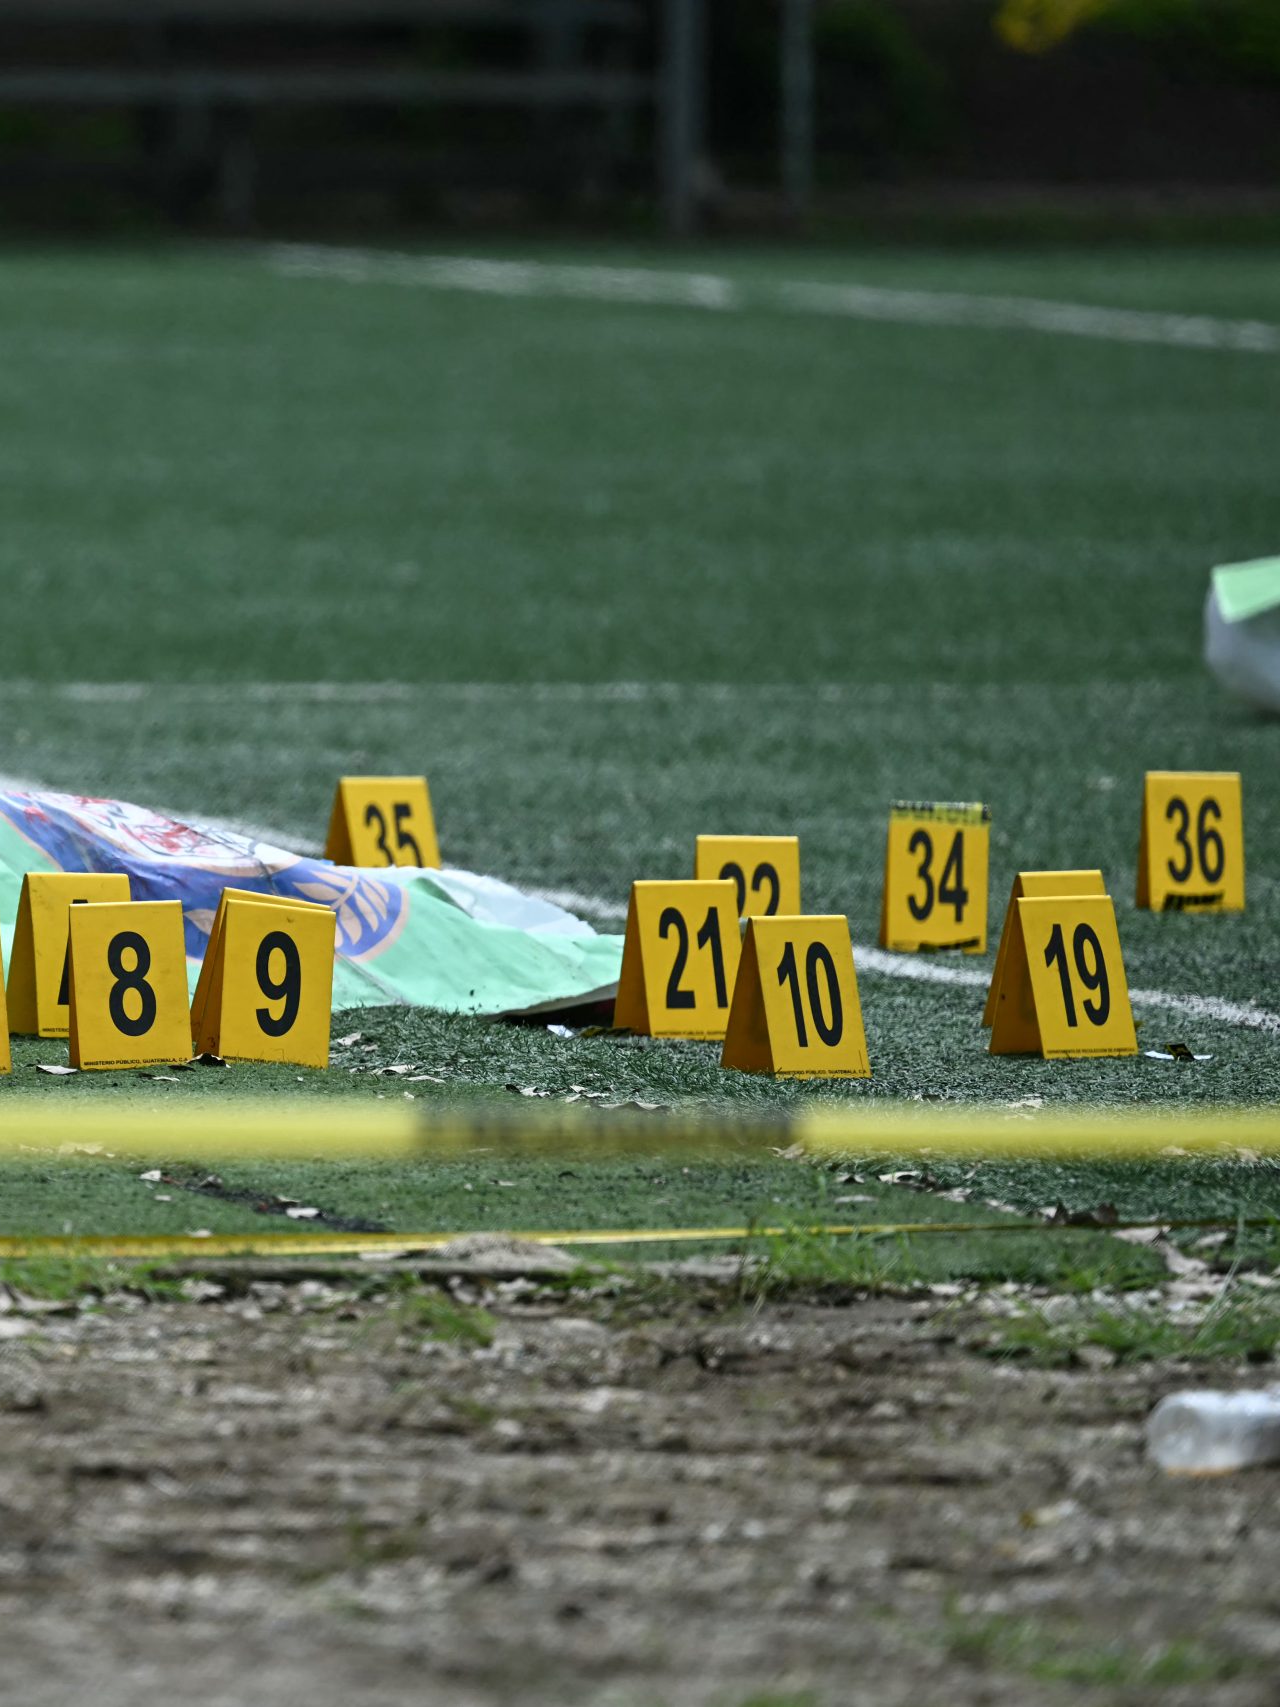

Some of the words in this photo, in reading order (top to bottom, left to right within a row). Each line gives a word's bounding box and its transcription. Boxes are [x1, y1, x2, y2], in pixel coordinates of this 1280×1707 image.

[365, 803, 423, 867] 35
[908, 830, 968, 923] 34
[1166, 798, 1225, 884] 36
[107, 931, 157, 1037] 8
[255, 930, 302, 1038] 9
[658, 906, 728, 1009] 21
[776, 941, 843, 1048] 10
[1044, 923, 1110, 1028] 19
